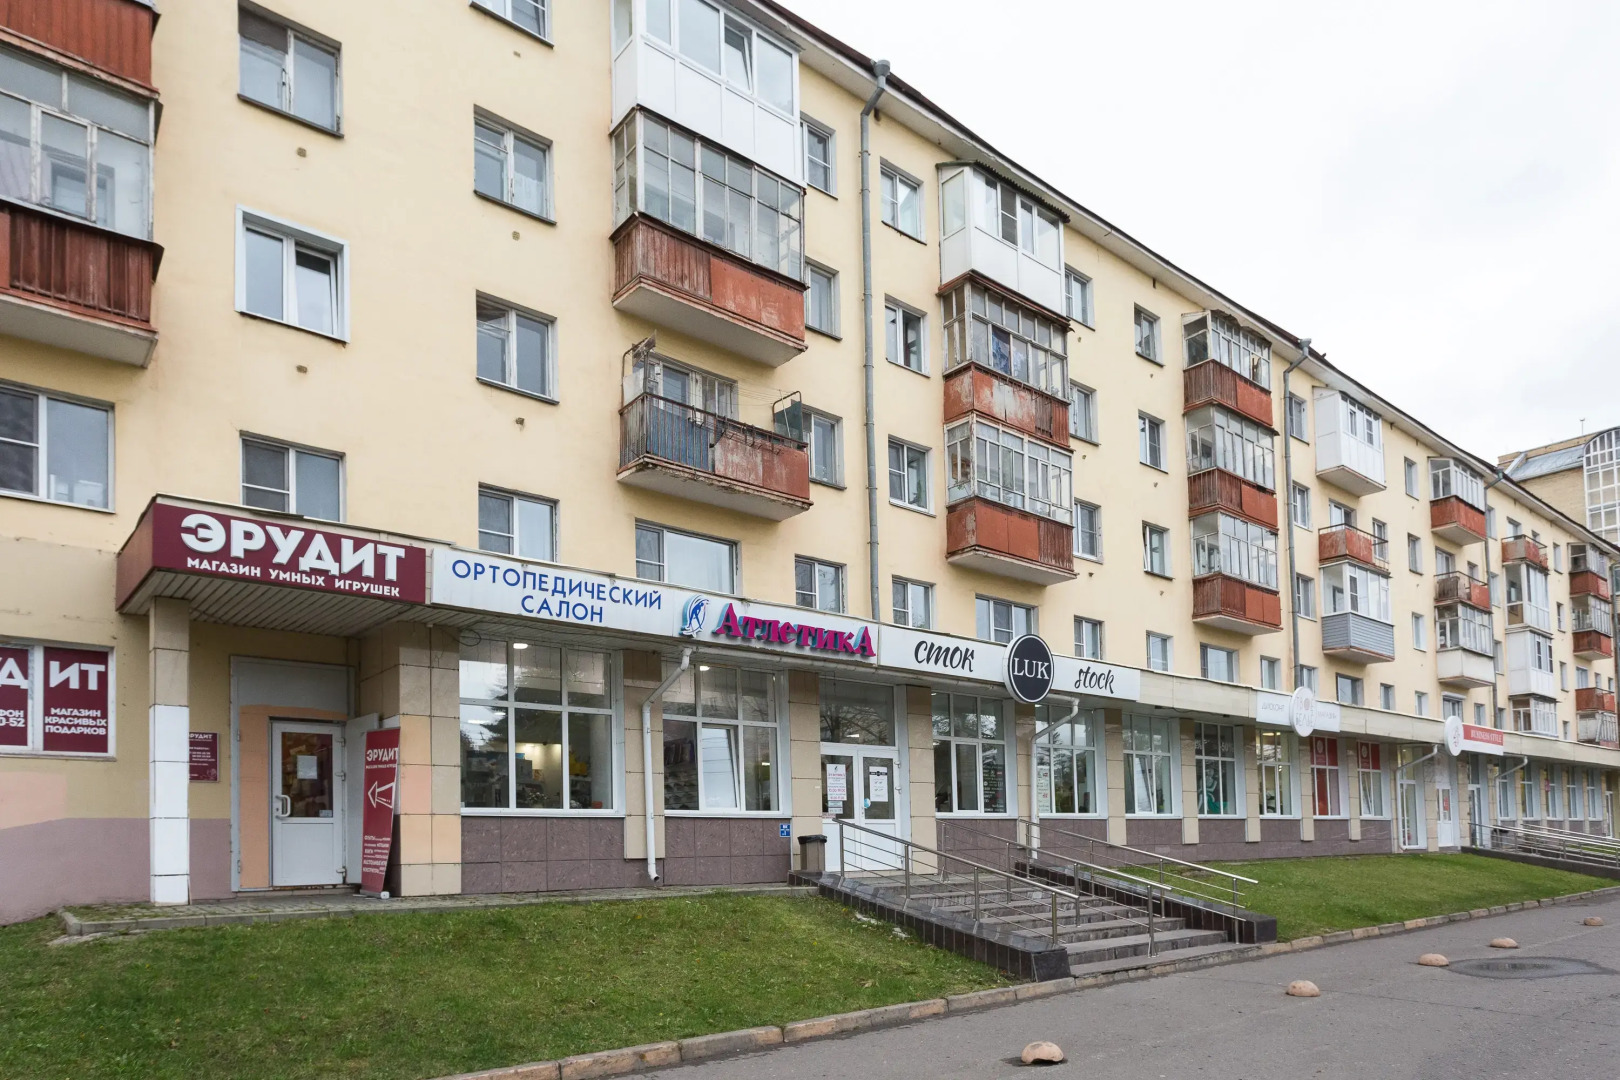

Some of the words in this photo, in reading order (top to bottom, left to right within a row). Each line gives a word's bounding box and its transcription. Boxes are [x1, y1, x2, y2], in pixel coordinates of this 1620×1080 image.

[180, 513, 405, 582] ЭРУДИТ
[187, 556, 261, 578] МАГАЗИН
[269, 568, 325, 587] УМНЫХ
[334, 578, 400, 597] ИГРУШЕК
[452, 559, 662, 610] ОРТОПЕДИЧЕСКИЙ
[521, 595, 603, 623] САЛОН
[1012, 656, 1050, 680] LUK
[1074, 667, 1115, 695] stock
[44, 716, 107, 727] КРАСИВЫХ
[50, 707, 101, 718] МАГАЗИН
[44, 725, 107, 736] ПОДАРКОВ
[366, 748, 398, 762] ЭРУДИТ
